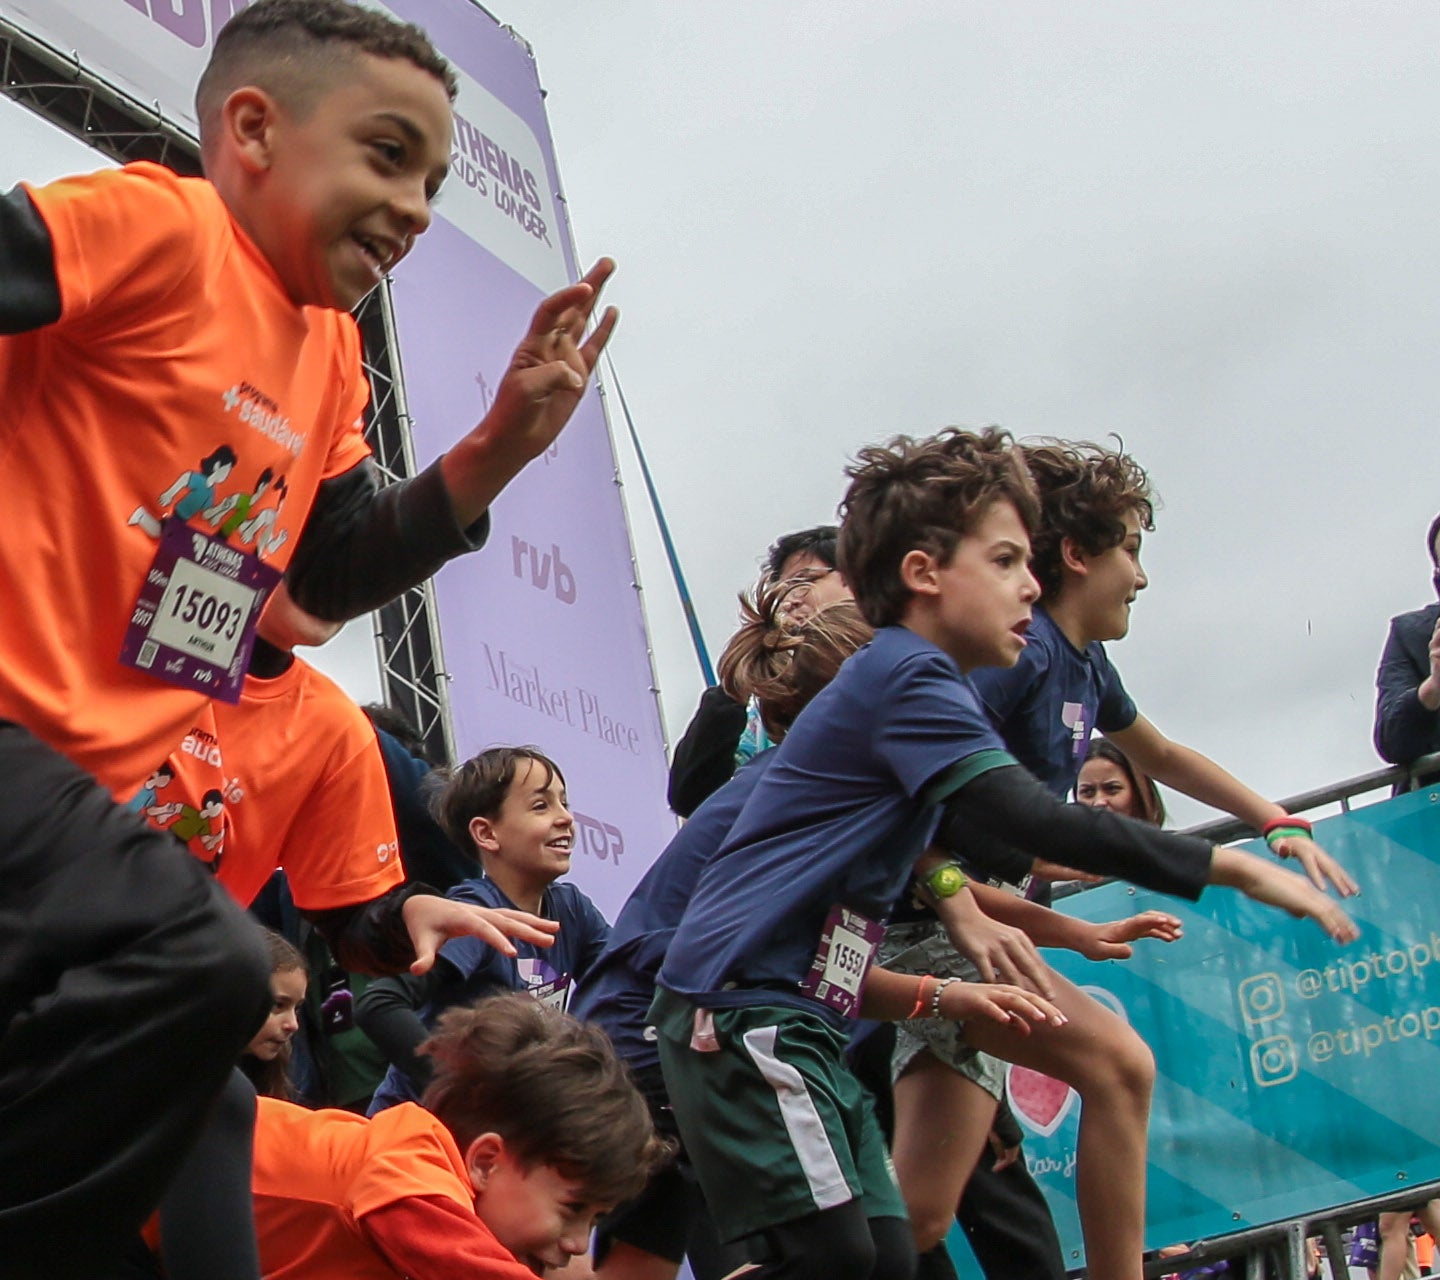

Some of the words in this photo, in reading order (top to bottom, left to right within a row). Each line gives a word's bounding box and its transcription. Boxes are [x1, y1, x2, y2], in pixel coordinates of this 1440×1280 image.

[452, 111, 541, 212] THENAS
[495, 181, 553, 248] LONGER
[511, 534, 577, 605] rvb
[171, 584, 242, 640] 15093
[481, 641, 574, 727] Market
[576, 687, 640, 756] Place
